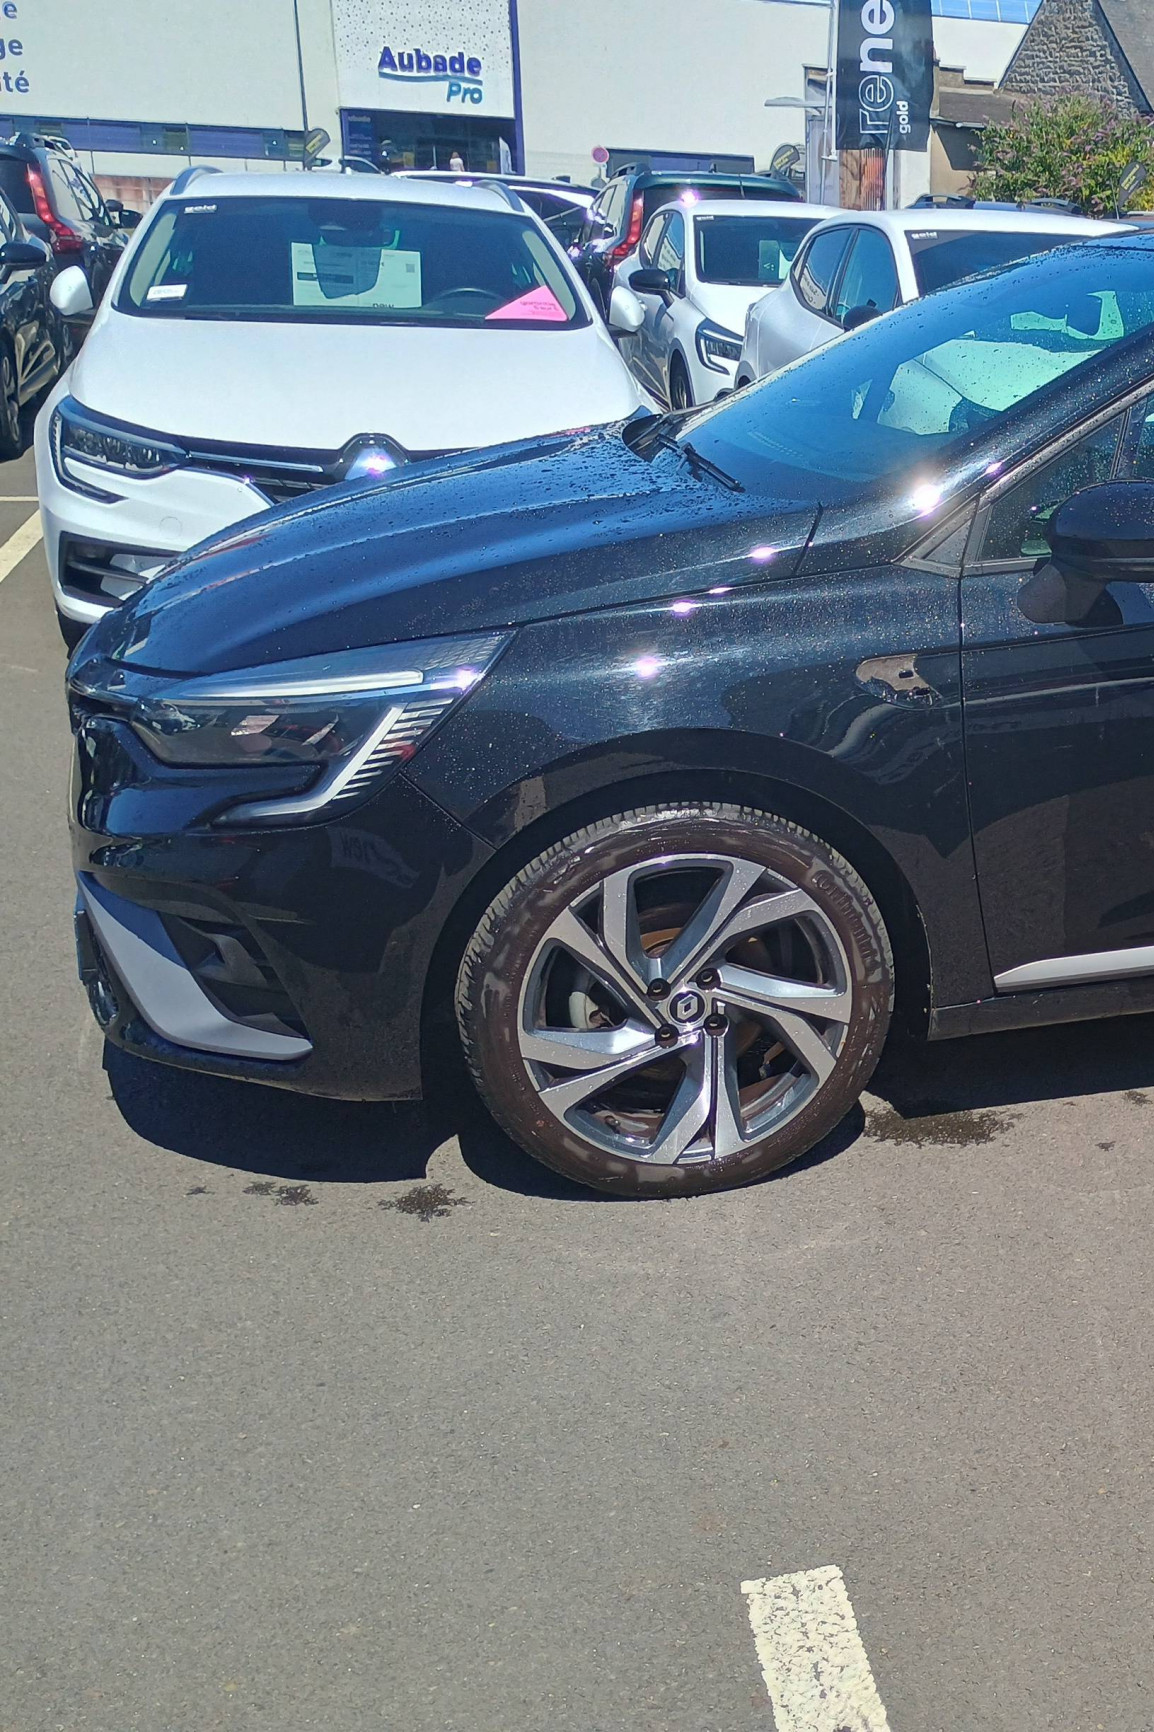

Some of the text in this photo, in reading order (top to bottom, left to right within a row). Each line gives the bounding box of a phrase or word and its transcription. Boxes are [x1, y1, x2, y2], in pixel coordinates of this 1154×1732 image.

[377, 45, 483, 77] Aubade
[0, 70, 30, 93] té
[446, 82, 484, 104] Pro
[896, 100, 912, 134] gold
